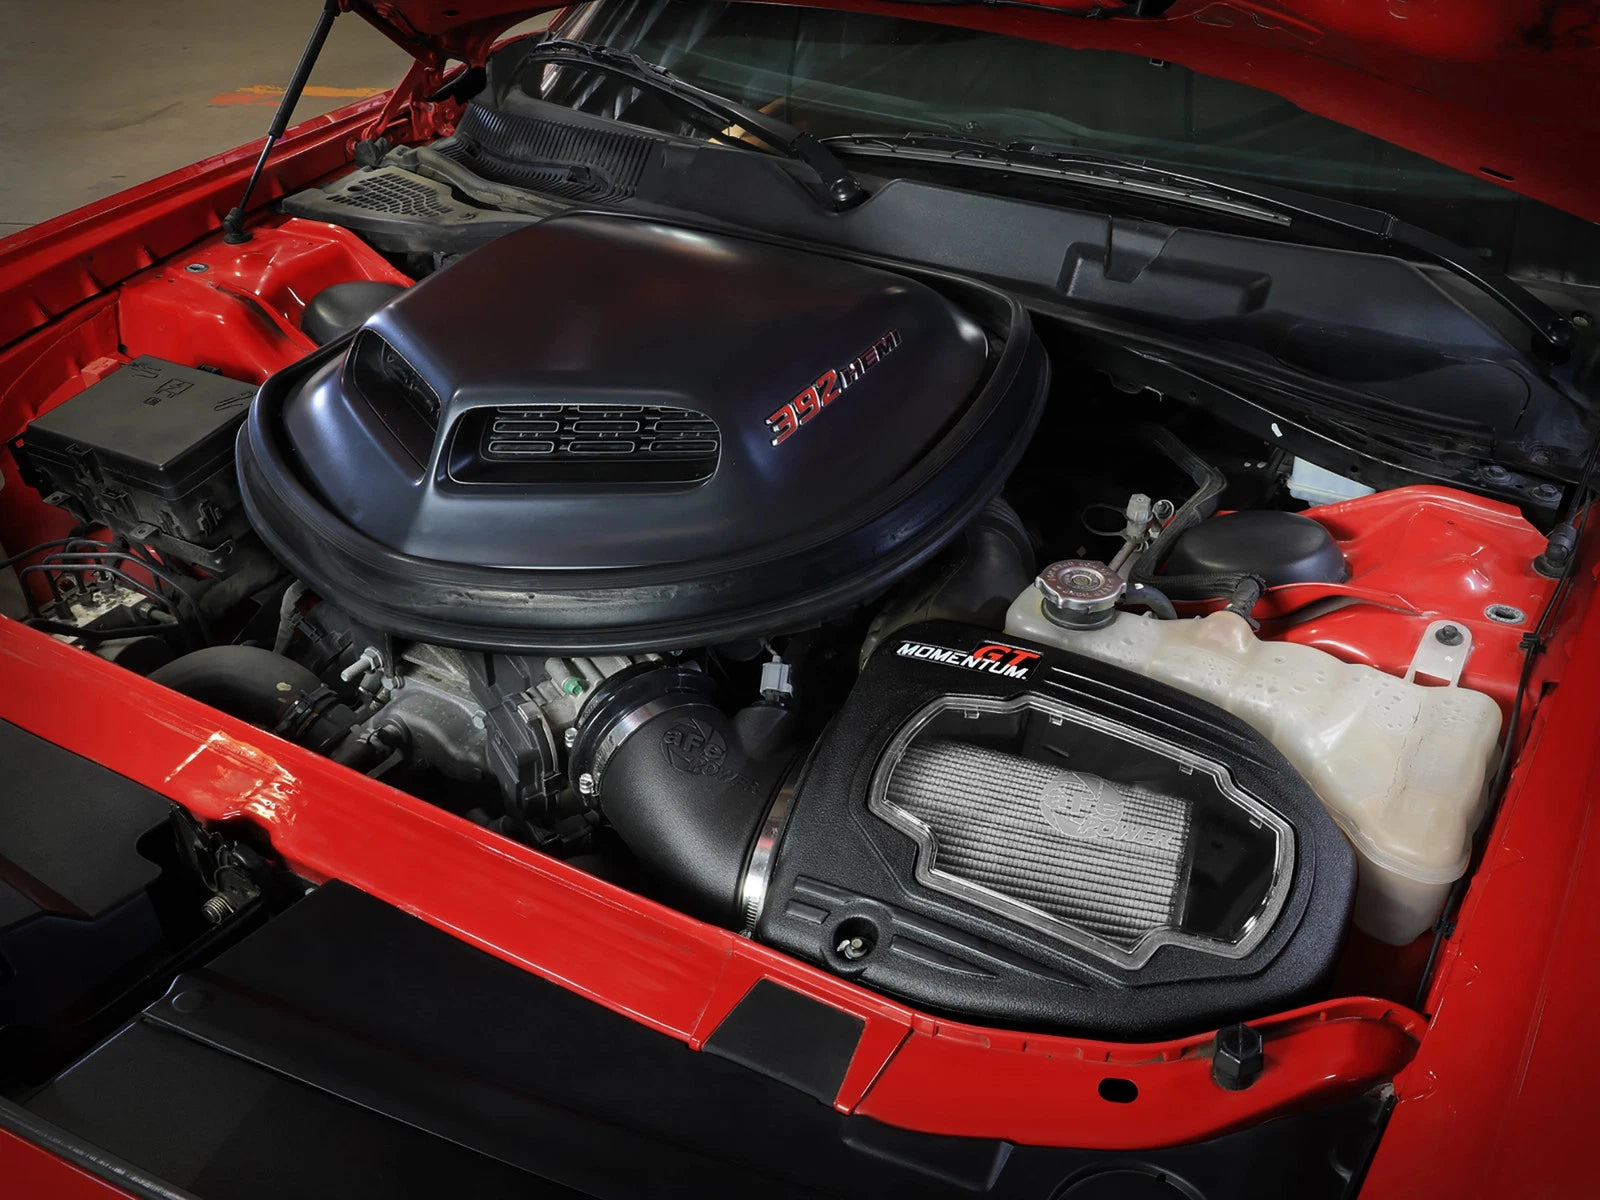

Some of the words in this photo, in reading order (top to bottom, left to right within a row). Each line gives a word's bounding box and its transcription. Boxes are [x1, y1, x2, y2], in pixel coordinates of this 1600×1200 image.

[765, 368, 842, 446] 392
[840, 328, 901, 388] HEMI
[972, 643, 1041, 667] GT
[1078, 813, 1176, 848] POWER
